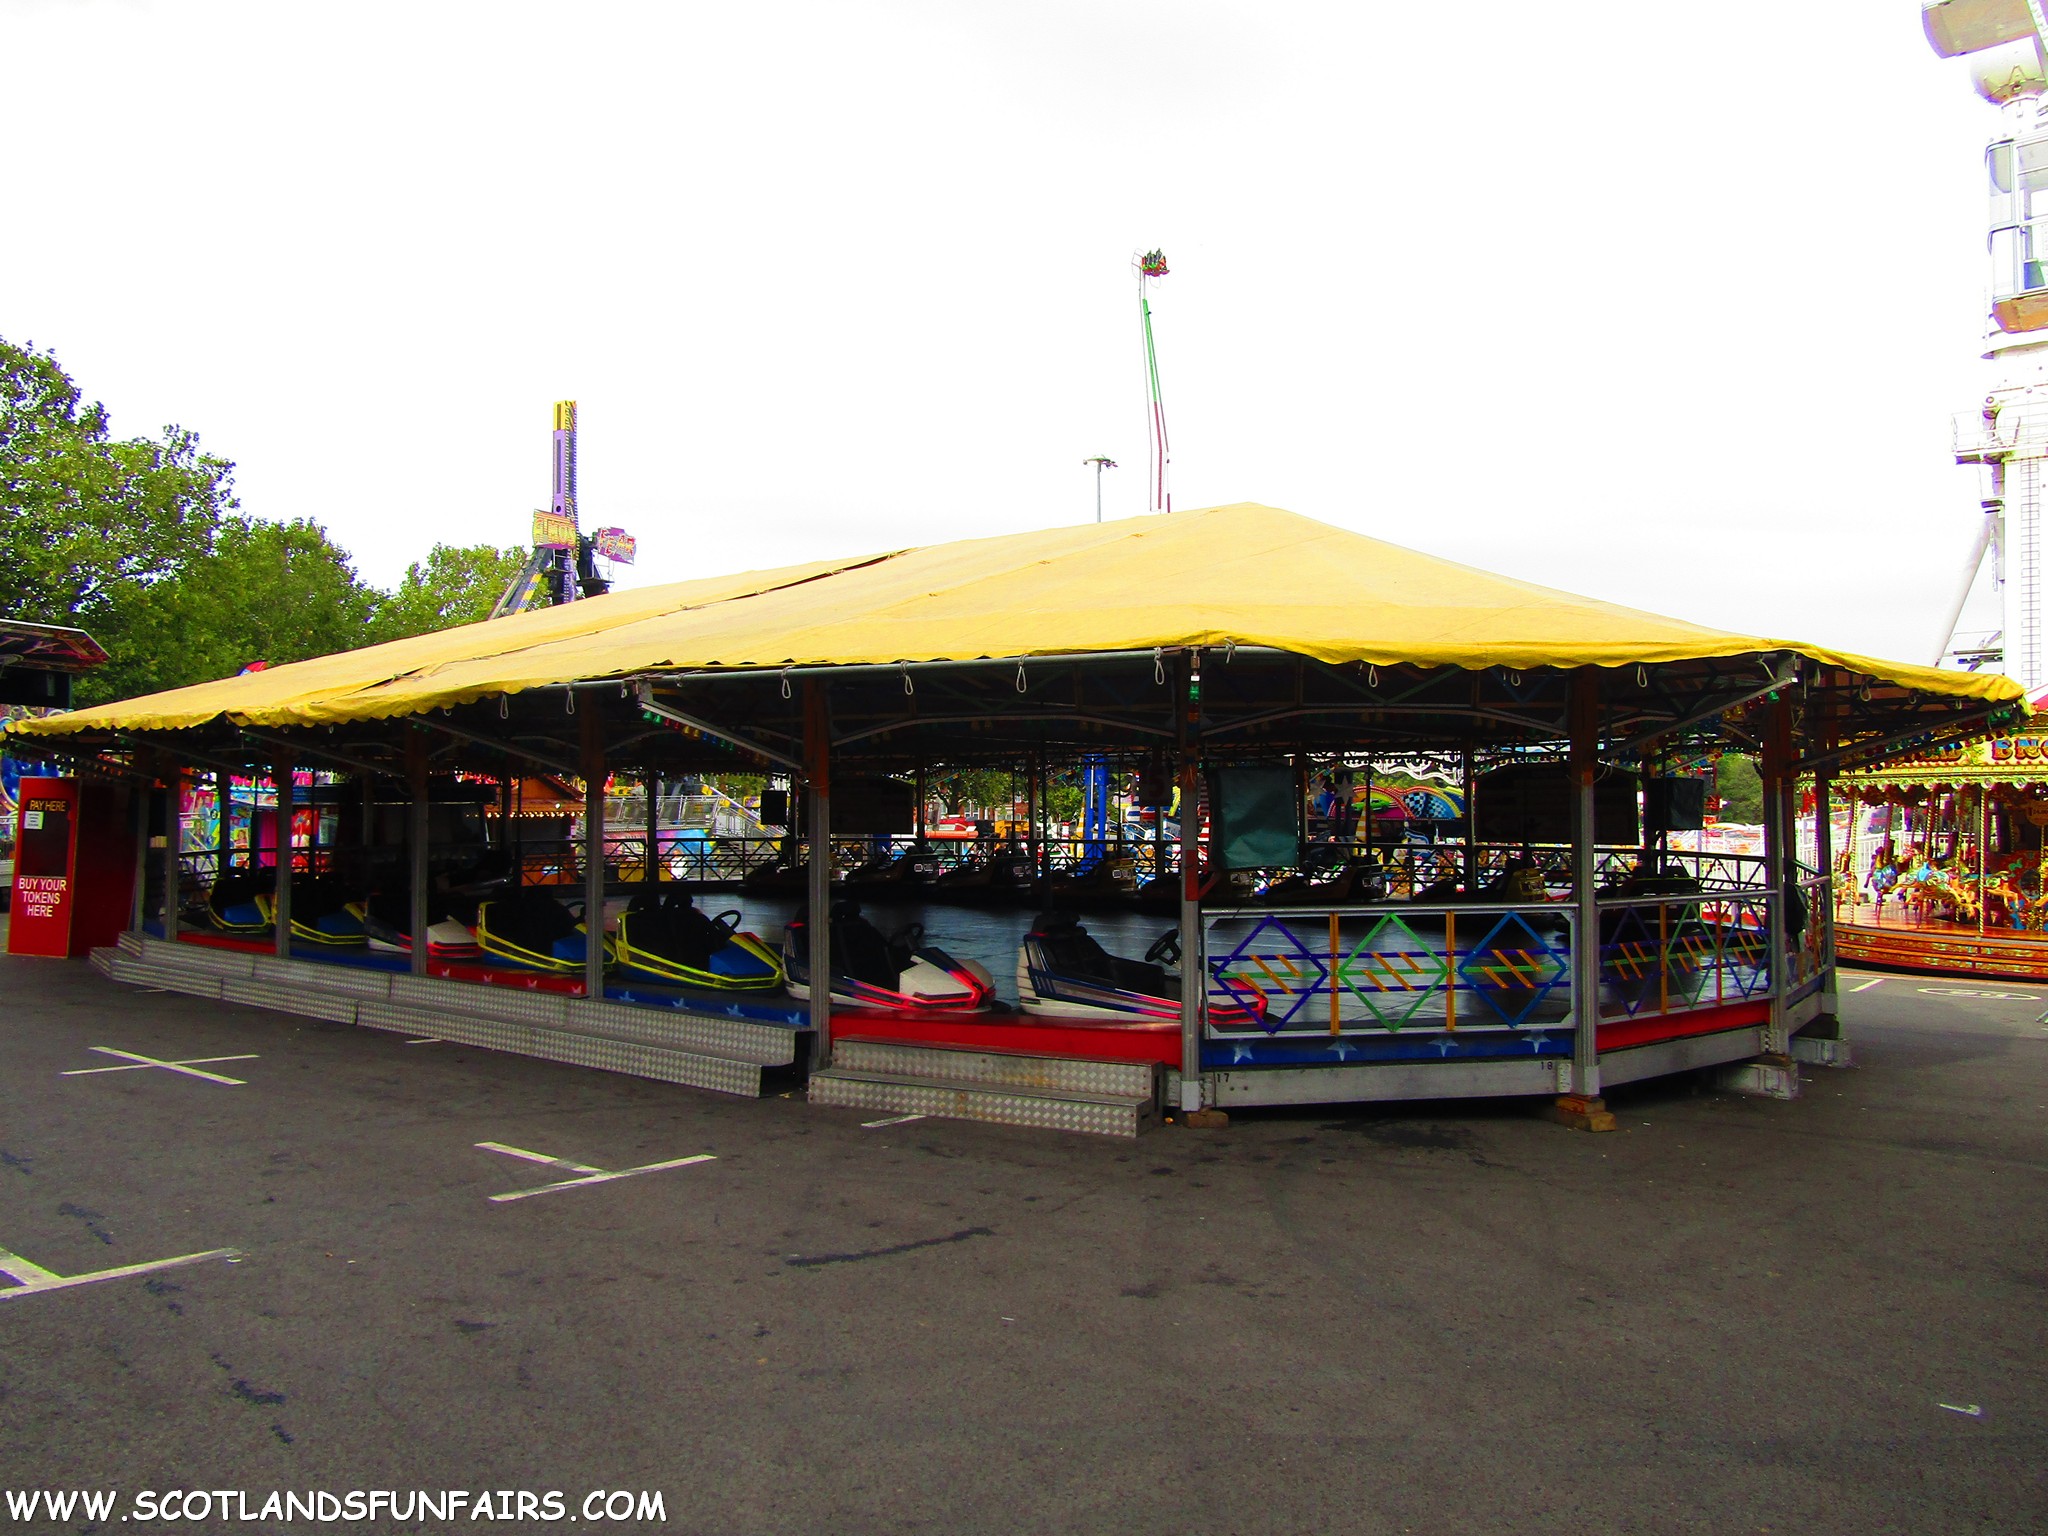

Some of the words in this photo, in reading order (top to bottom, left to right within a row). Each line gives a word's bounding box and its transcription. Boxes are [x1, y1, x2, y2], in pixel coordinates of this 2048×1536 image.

[29, 800, 45, 811] PAY
[45, 801, 66, 812] HERE
[19, 877, 39, 890] BUY
[40, 879, 67, 891] YOUR
[22, 891, 61, 905] TOKENS
[27, 905, 54, 917] HERE
[1541, 1061, 1553, 1070] 18
[1217, 1072, 1230, 1083] 17
